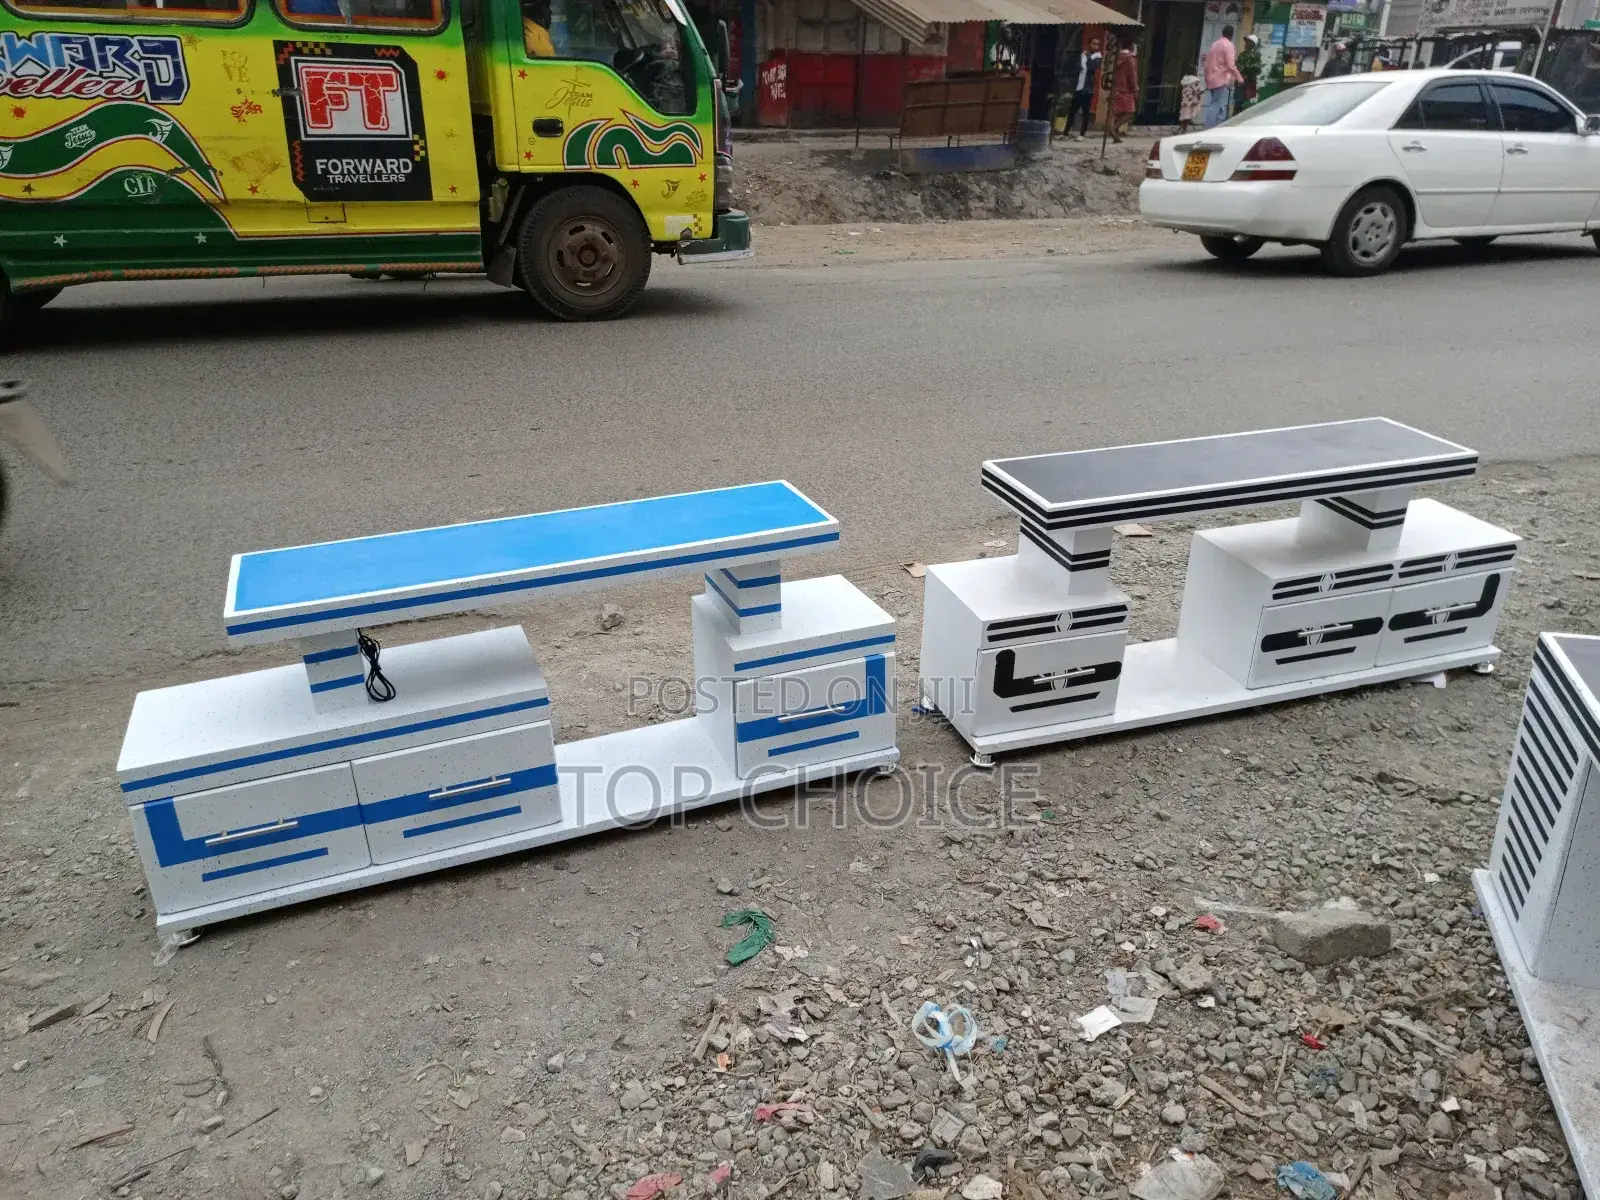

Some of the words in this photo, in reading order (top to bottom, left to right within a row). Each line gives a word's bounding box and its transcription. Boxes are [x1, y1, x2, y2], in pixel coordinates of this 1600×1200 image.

[0, 33, 188, 104] WARD
[299, 66, 399, 130] FT
[316, 158, 412, 174] FORWARD
[327, 174, 406, 183] TRAVELLERS
